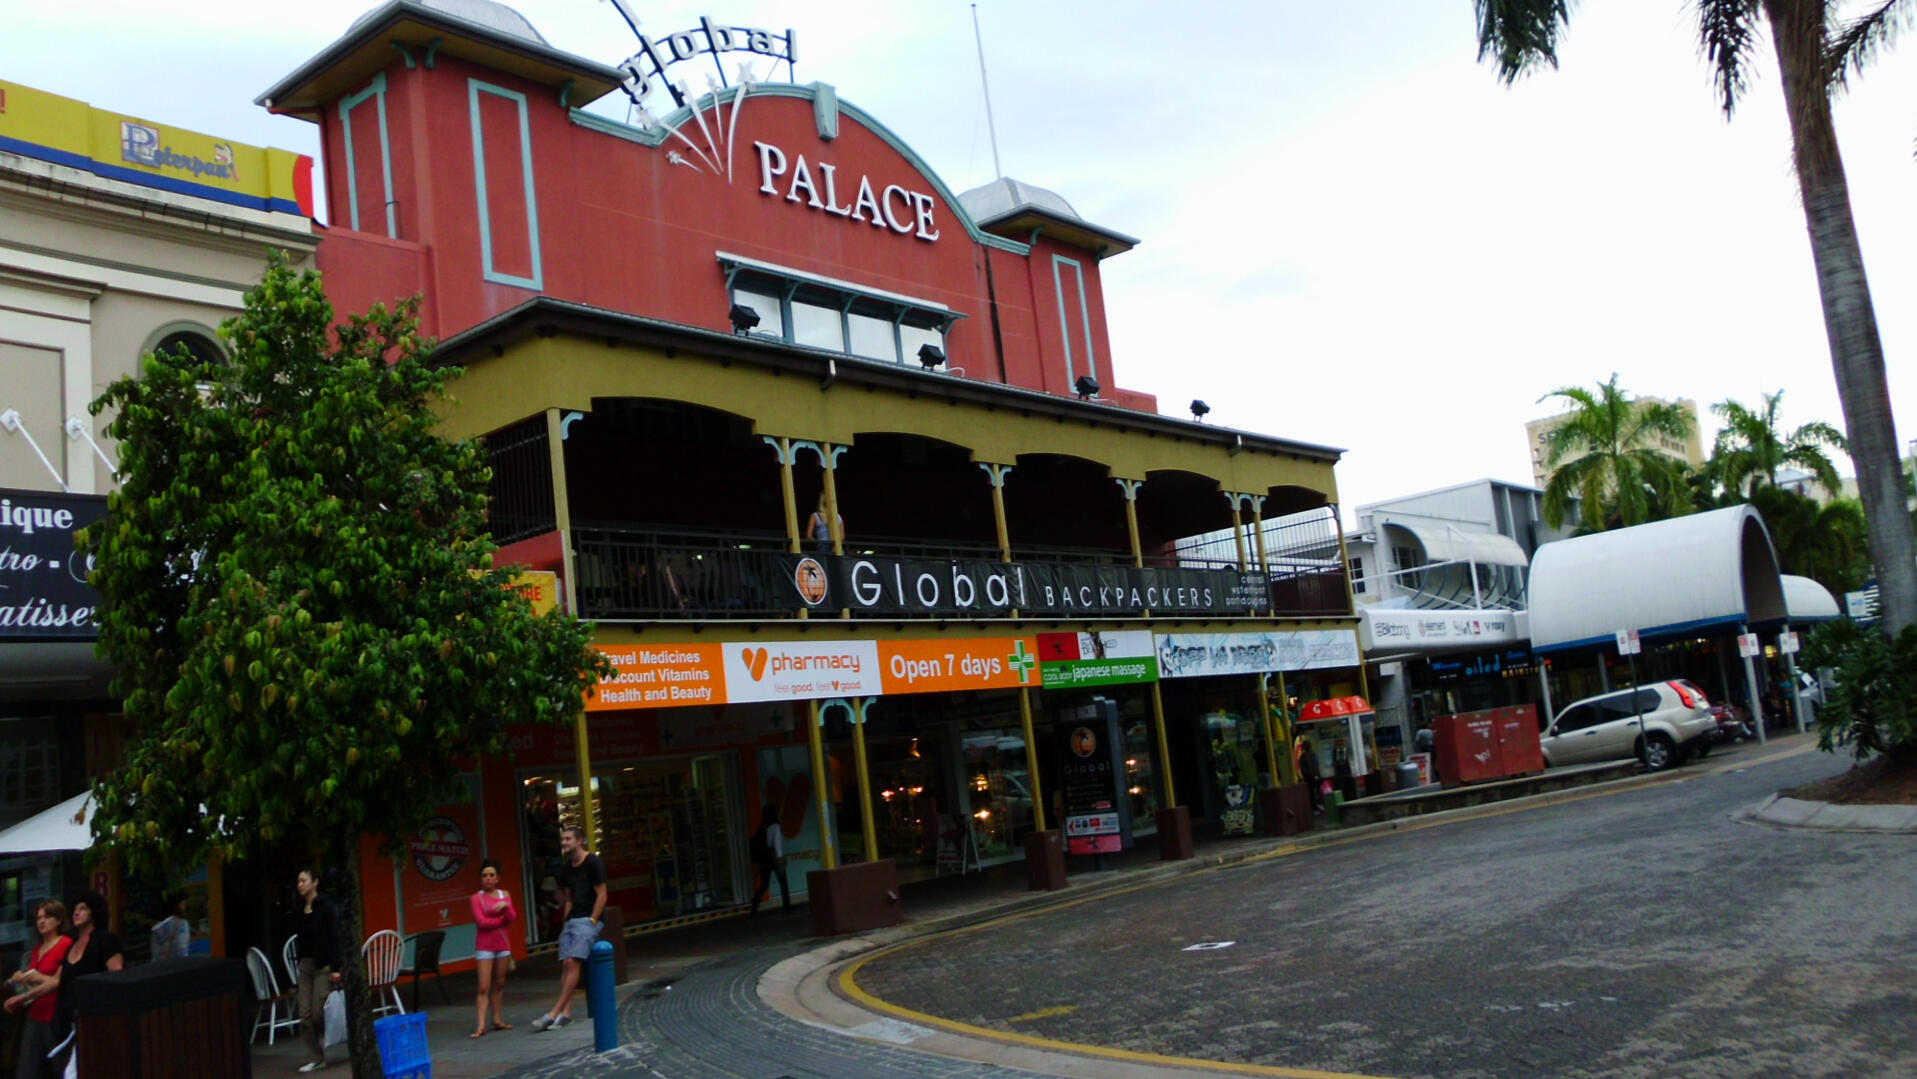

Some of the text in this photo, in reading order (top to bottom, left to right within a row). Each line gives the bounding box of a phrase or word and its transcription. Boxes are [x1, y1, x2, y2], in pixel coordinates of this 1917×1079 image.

[619, 15, 798, 105] global
[122, 124, 231, 178] Peterpan
[754, 140, 939, 241] PALACE
[852, 560, 1212, 608] Global BACKPACKERS
[640, 650, 701, 665] Medicines
[772, 652, 861, 675] pharmacy
[891, 653, 1001, 683] Open 7 days
[658, 667, 710, 682] Vitamins
[1072, 664, 1110, 682] japanese
[1111, 664, 1146, 678] massage
[600, 685, 712, 702] Health and Beauty
